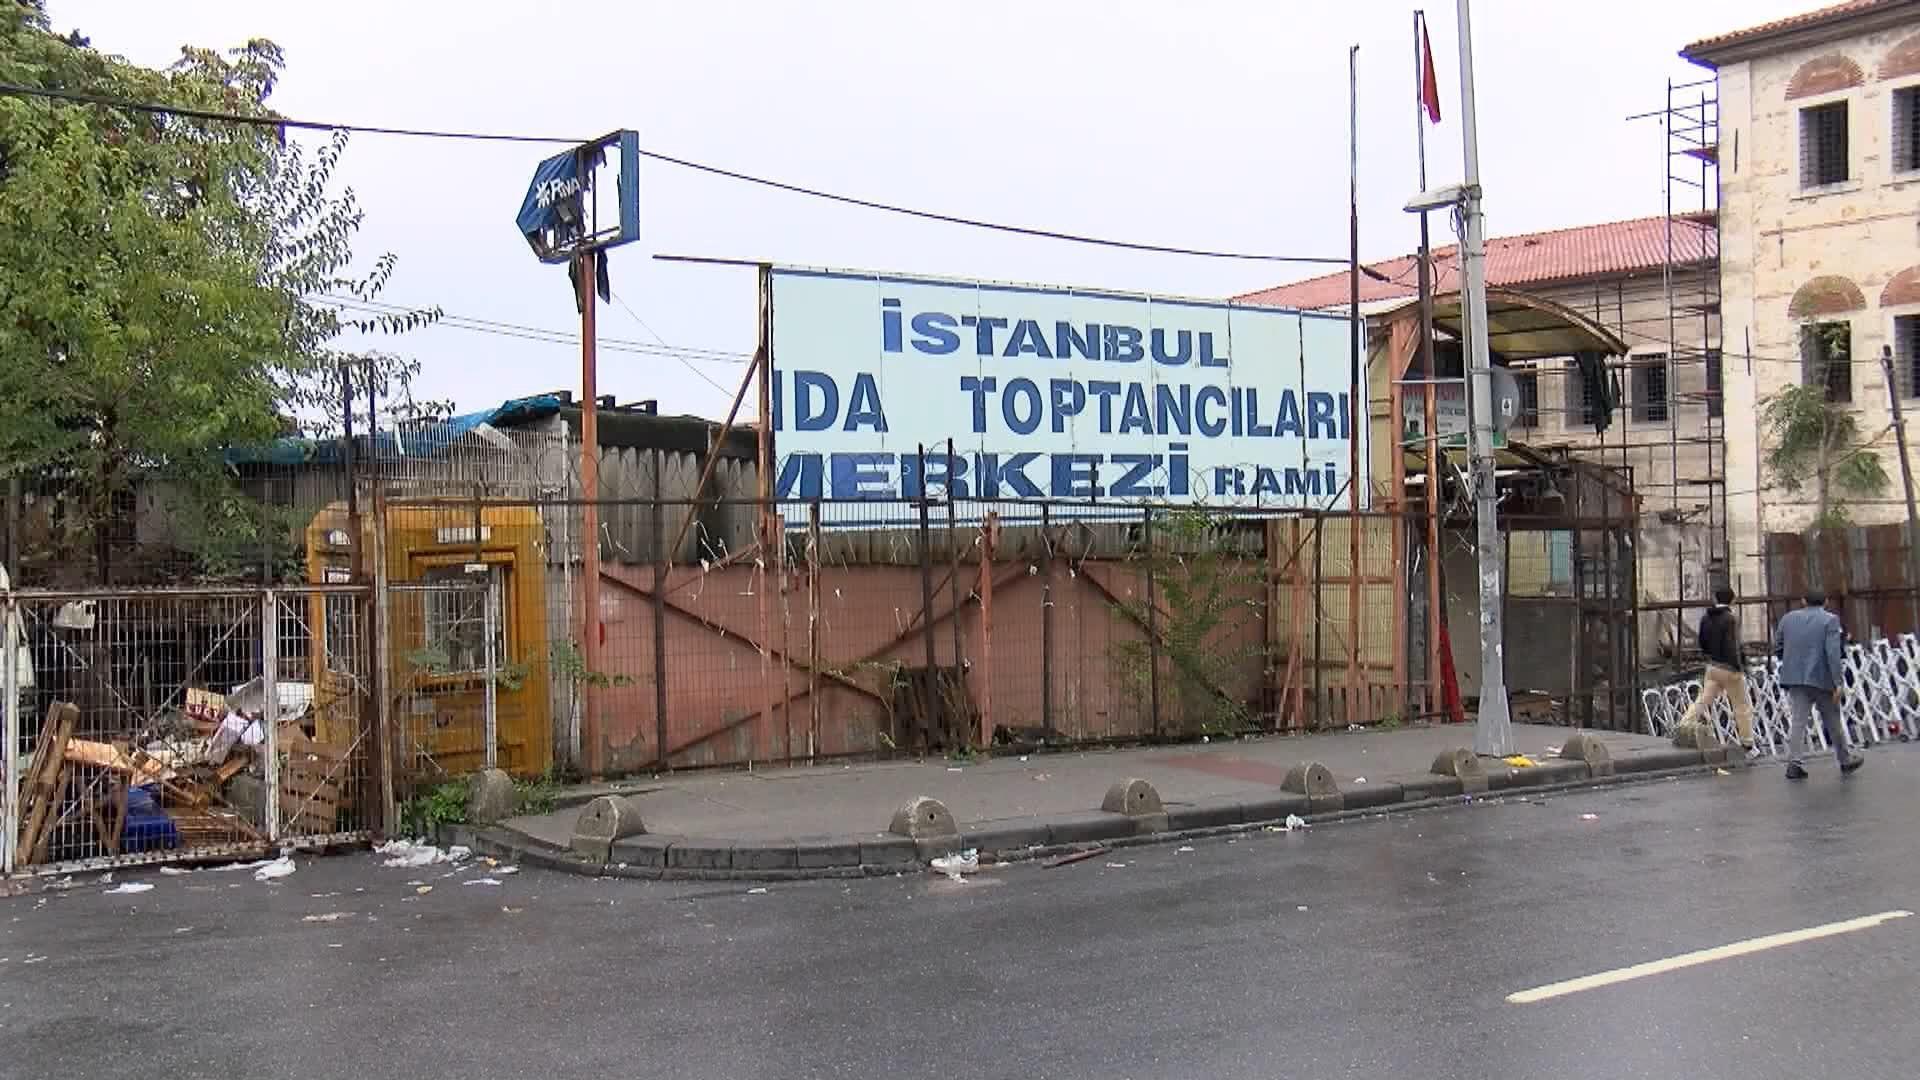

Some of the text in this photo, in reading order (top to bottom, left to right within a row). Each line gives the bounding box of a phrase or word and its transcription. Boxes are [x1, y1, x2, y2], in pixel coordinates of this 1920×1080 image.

[882, 297, 1230, 368] İSTANBUL
[960, 375, 1350, 441] TOPTANCILARI
[1214, 462, 1337, 496] RAMİ
